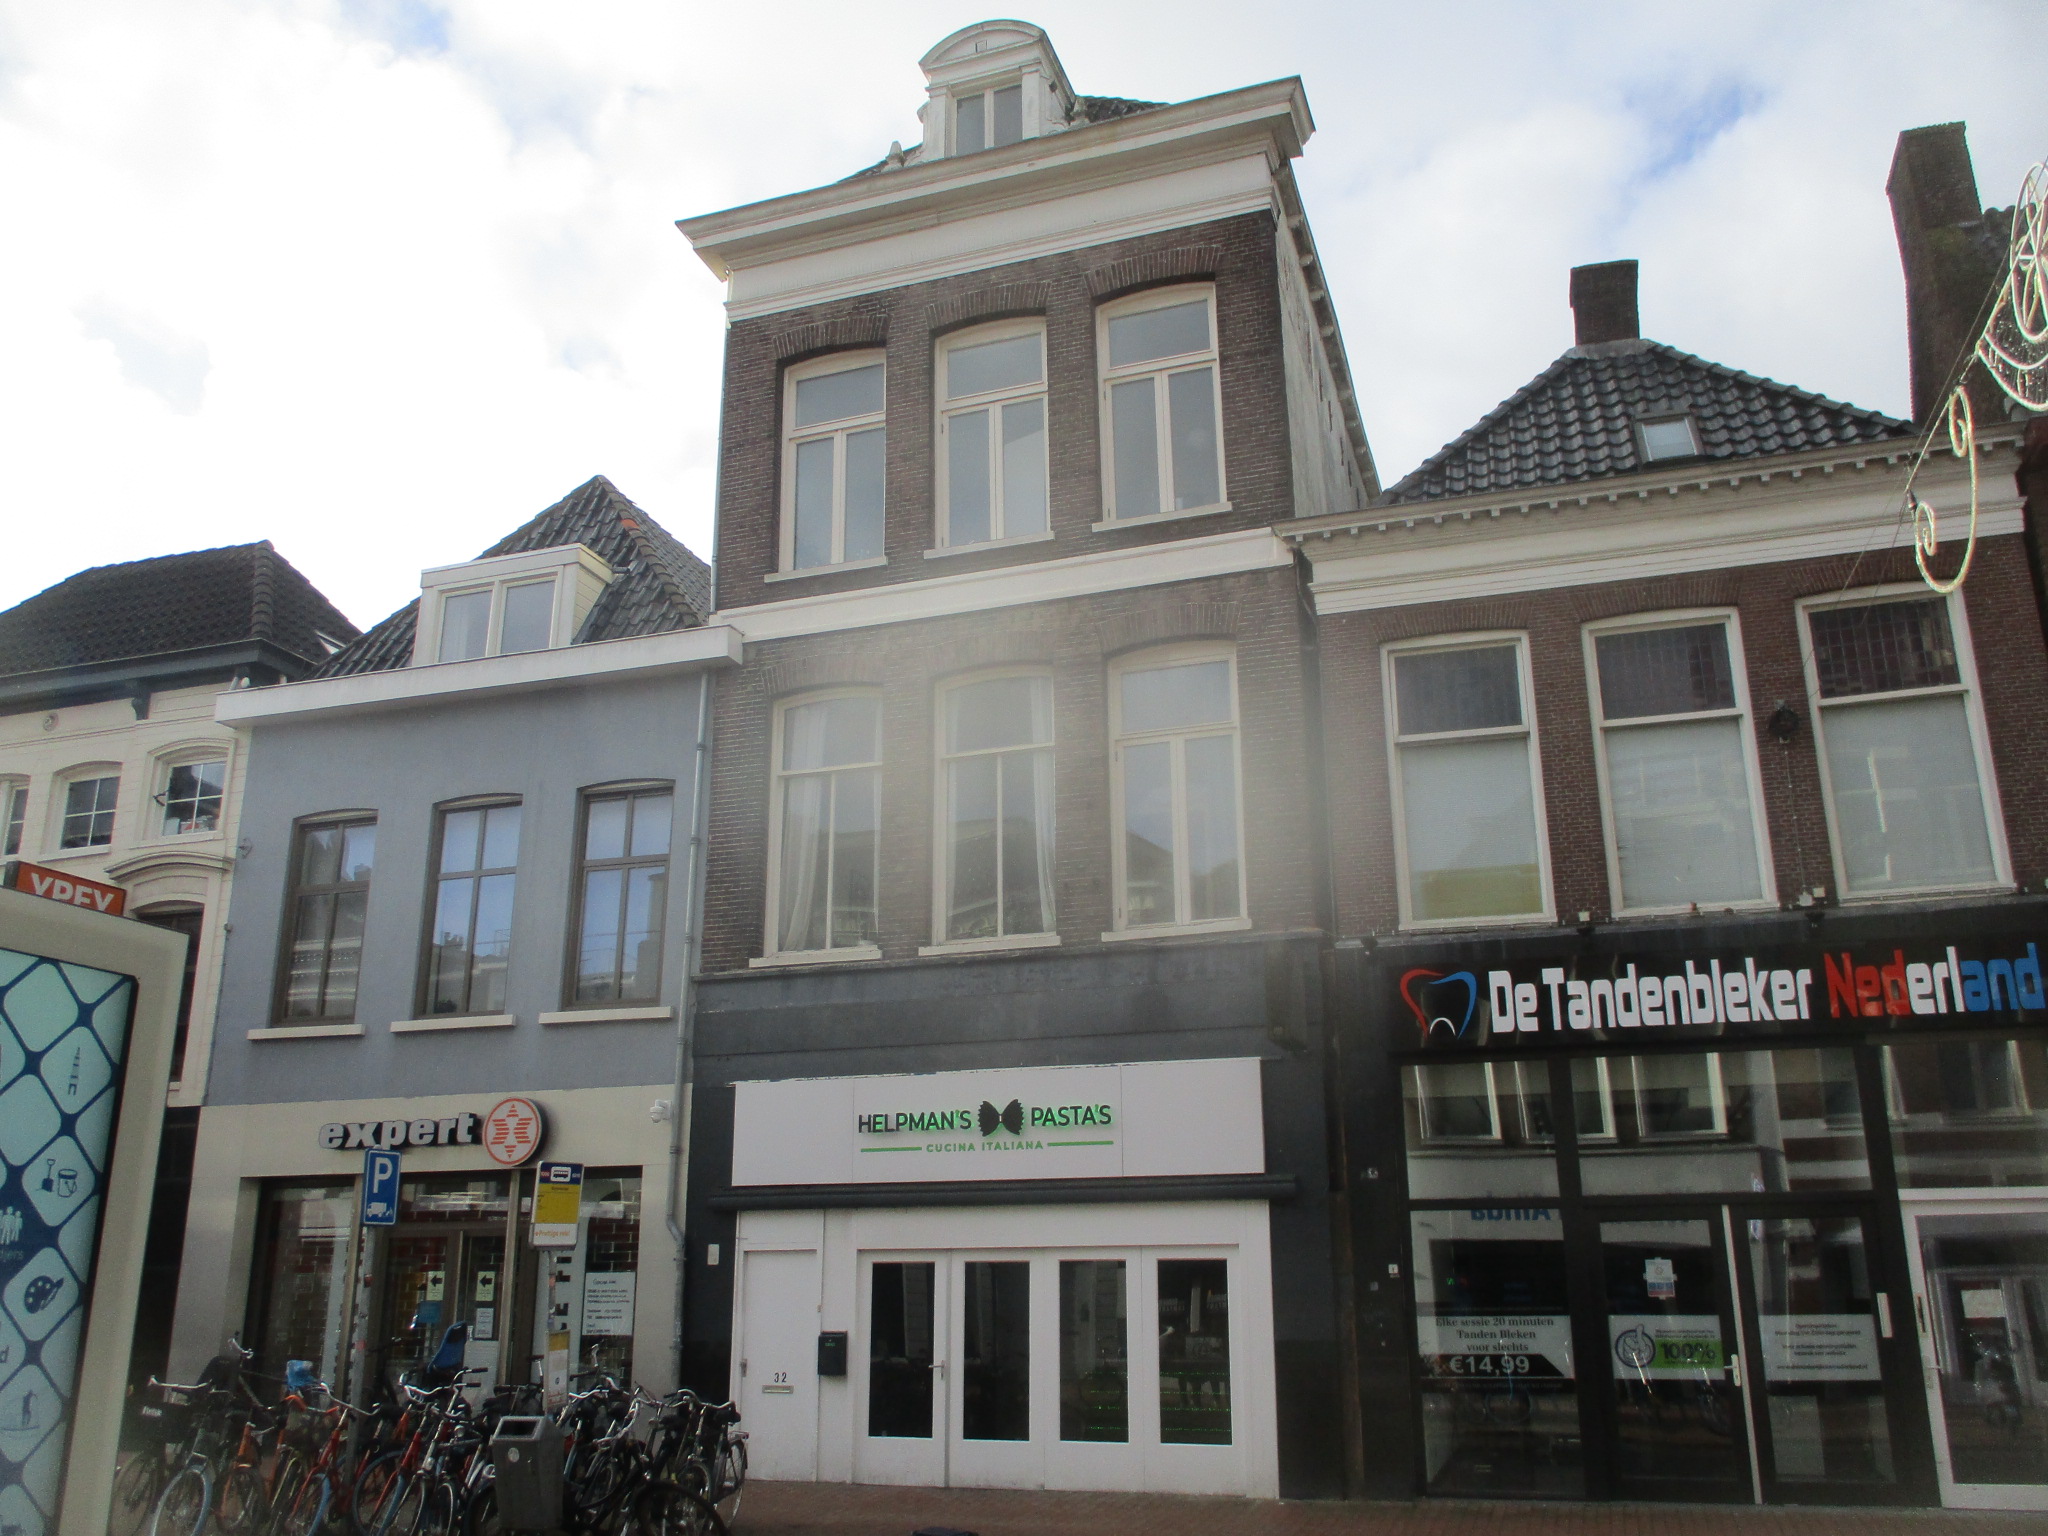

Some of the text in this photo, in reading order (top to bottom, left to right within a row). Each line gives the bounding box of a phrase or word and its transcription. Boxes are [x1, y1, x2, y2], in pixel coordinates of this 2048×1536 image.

[1488, 942, 2046, 1033] De Tandenbleker Nederland
[858, 1103, 1112, 1134] HELPMAN'S PASTA'S
[318, 1111, 474, 1150] expert
[926, 1141, 1043, 1153] CUCINA ITALIANA
[373, 1157, 393, 1194] P
[1460, 1317, 1490, 1327] sessie
[1493, 1317, 1505, 1326] 20
[1508, 1316, 1554, 1326] minuten
[1456, 1329, 1536, 1339] Tanden Bleken
[1467, 1342, 1529, 1352] voor slechts
[1661, 1342, 1716, 1362] 100%
[1449, 1355, 1530, 1376] €14,99
[773, 1371, 787, 1383] 32
